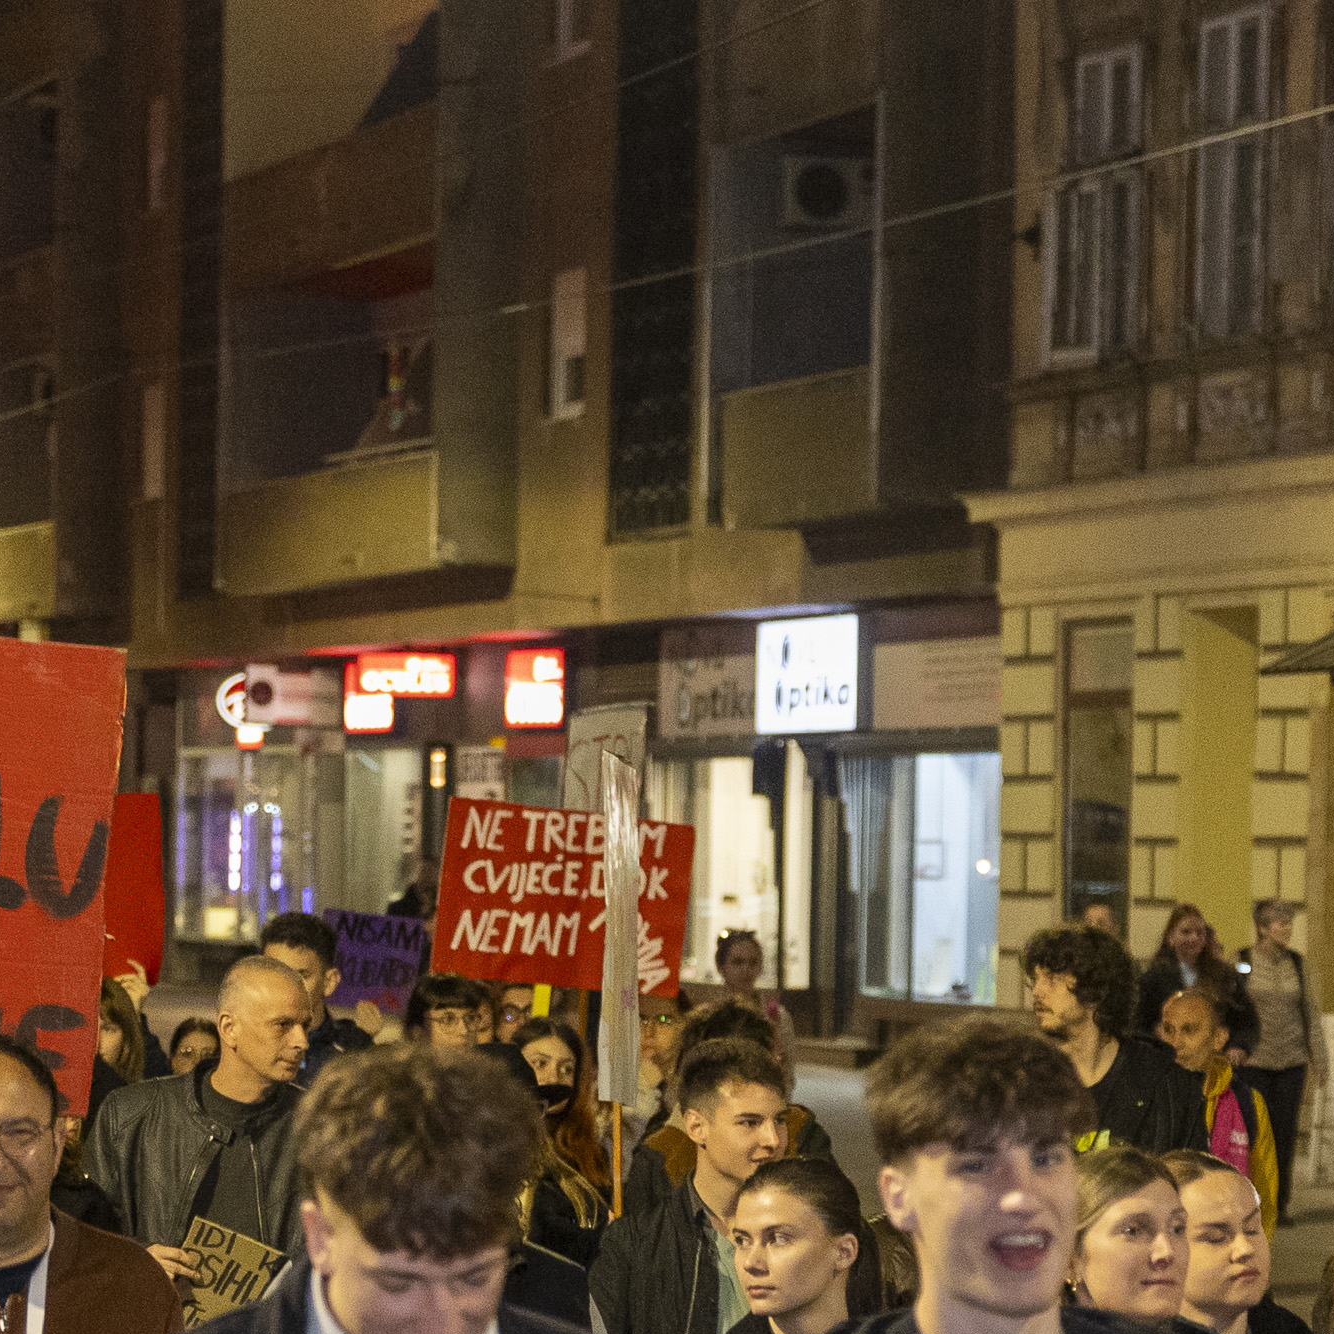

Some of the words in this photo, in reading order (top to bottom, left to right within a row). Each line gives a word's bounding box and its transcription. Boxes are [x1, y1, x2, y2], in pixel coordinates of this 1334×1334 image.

[460, 805, 514, 851] NE
[521, 810, 667, 859] TREBM
[450, 908, 582, 957] NEMAM
[192, 1222, 237, 1255] IDI
